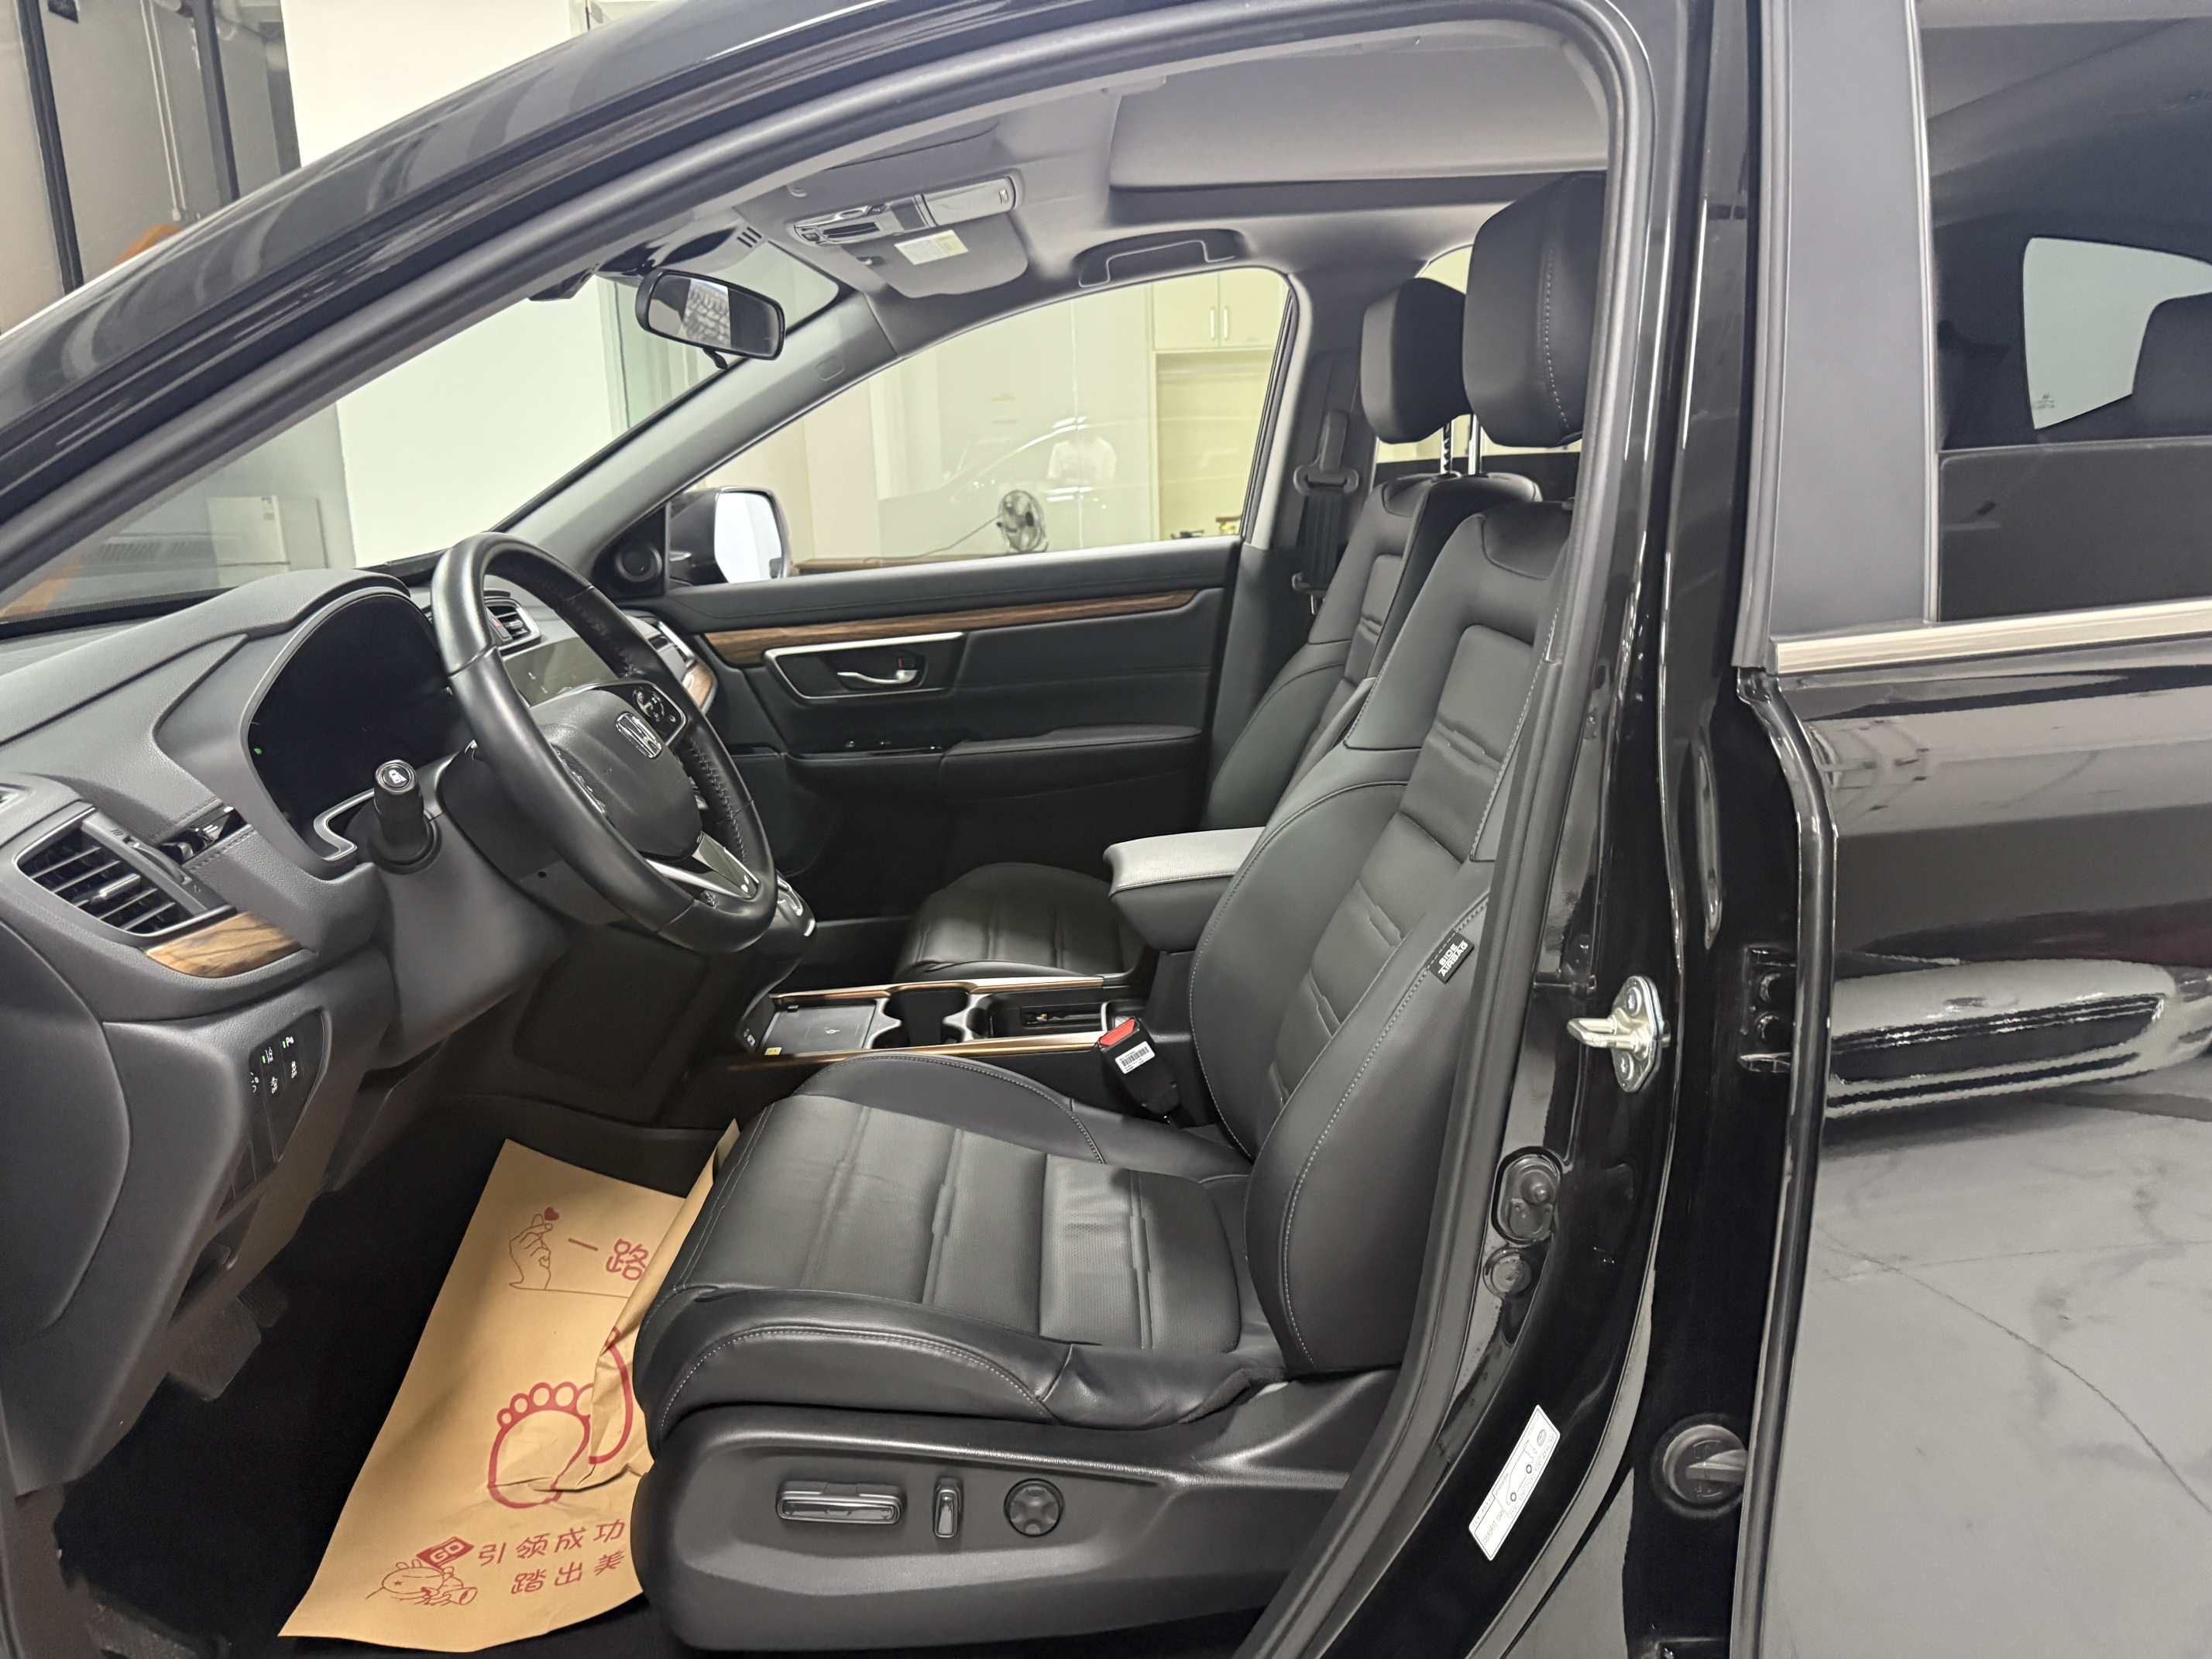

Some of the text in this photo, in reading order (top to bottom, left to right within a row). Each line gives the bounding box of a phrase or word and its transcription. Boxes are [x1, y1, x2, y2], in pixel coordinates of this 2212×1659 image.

[1439, 943, 1458, 966] SIDE
[1440, 941, 1468, 977] AIRBAG
[429, 1540, 465, 1564] GO
[478, 1519, 626, 1567] 引领成功
